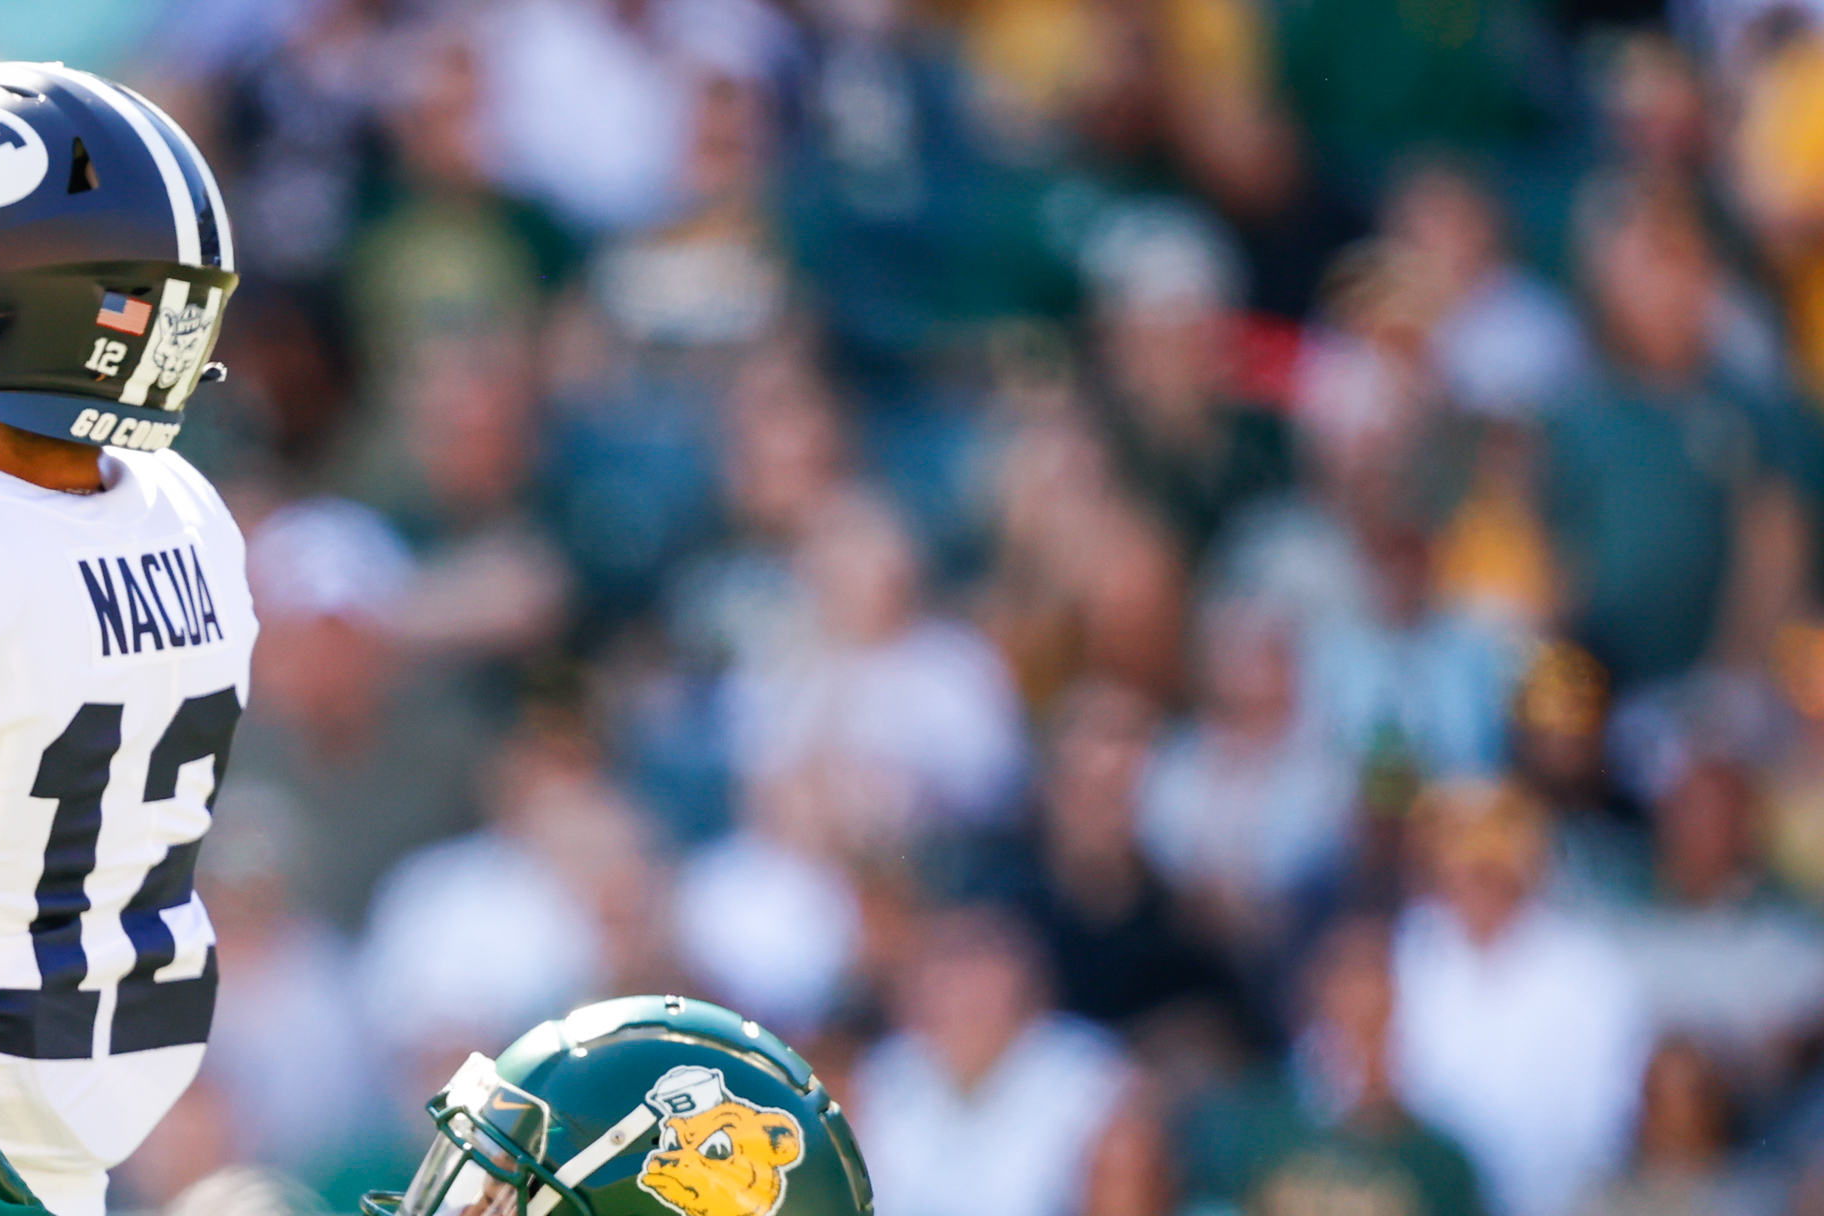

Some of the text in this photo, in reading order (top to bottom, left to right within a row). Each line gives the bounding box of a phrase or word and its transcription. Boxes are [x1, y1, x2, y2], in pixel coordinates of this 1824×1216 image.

[84, 337, 129, 377] 12
[70, 408, 118, 442] GO
[78, 543, 225, 657] NACUA
[663, 1093, 696, 1114] B
